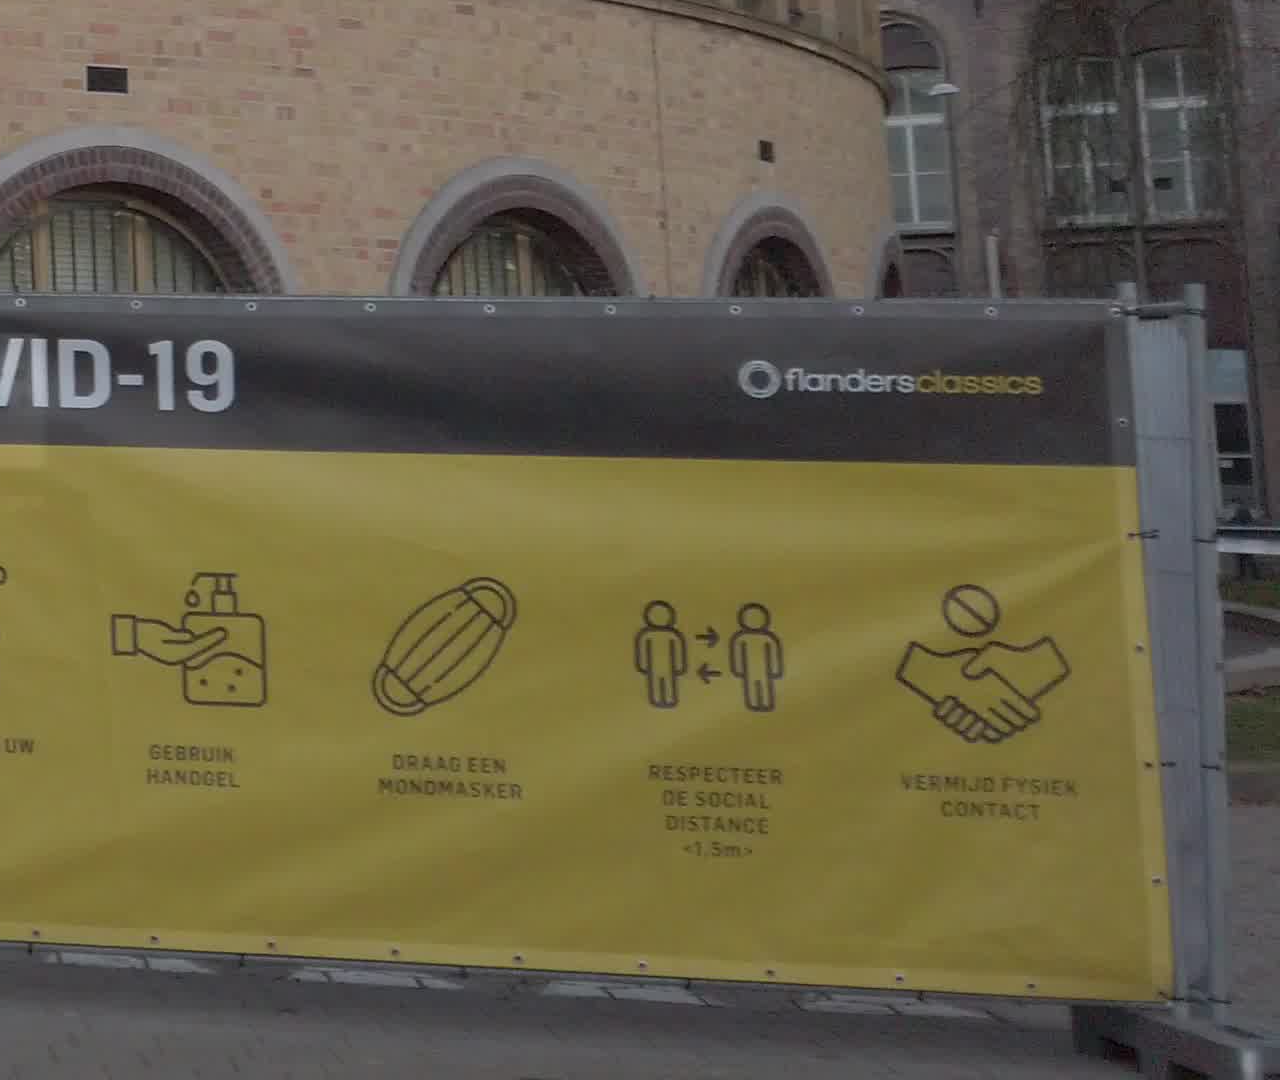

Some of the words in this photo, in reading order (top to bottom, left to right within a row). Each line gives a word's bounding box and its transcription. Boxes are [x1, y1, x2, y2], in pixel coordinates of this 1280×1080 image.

[5, 738, 35, 754] UW
[149, 743, 234, 763] GEBRUIK
[391, 753, 462, 773] DRAAG
[468, 756, 506, 774] EEN
[146, 768, 240, 788] HANDGEL
[648, 764, 783, 785] RESPECTEER
[378, 777, 523, 800] MONDMASKER
[900, 773, 996, 793] VERMIJD
[1001, 777, 1079, 797] FYSIEK
[663, 789, 689, 807] DE
[695, 792, 770, 810] SOCIAL
[941, 800, 1041, 820] CONTACT
[665, 815, 770, 835] DISTANCE
